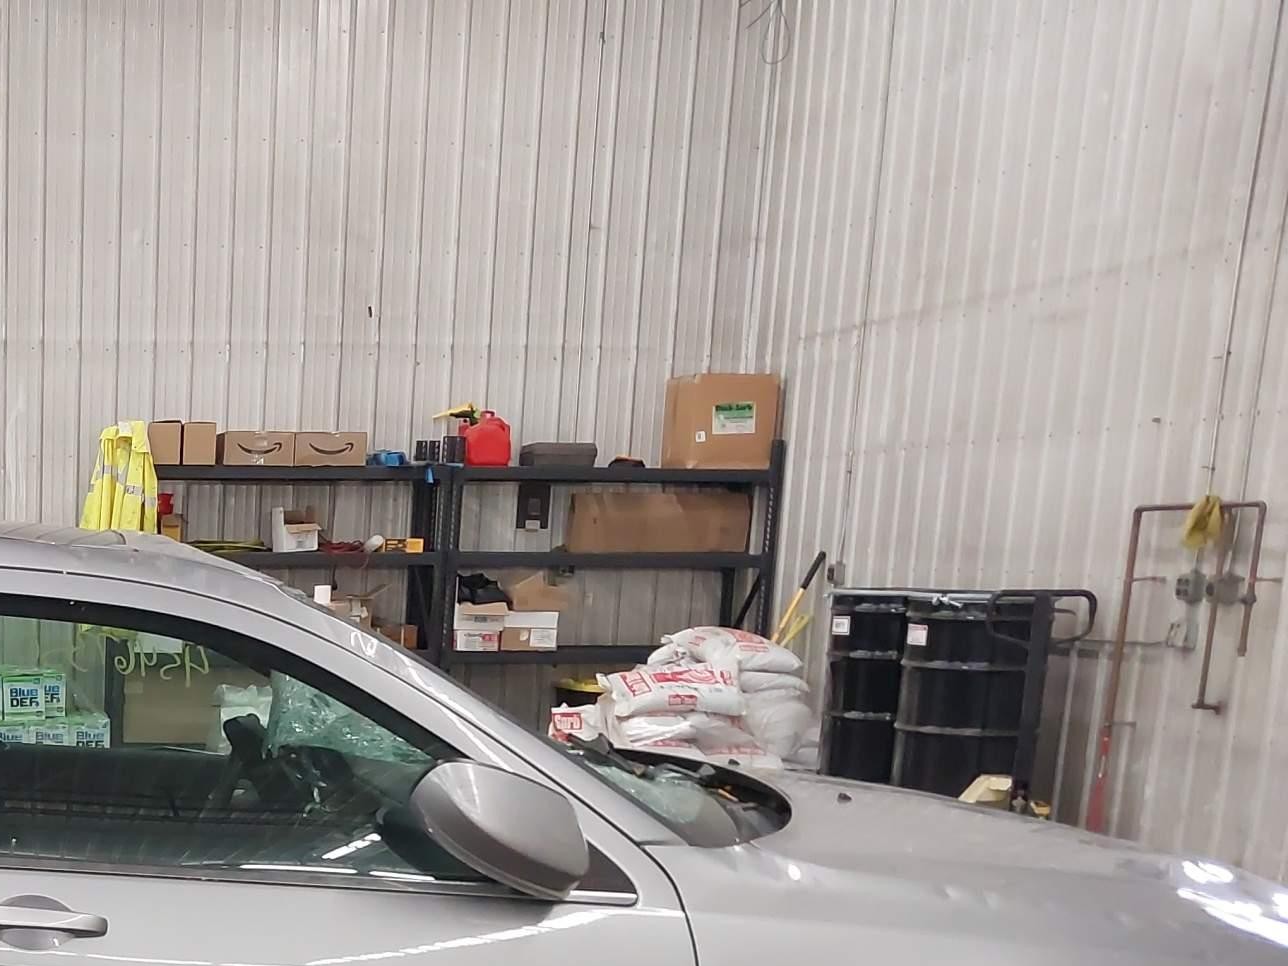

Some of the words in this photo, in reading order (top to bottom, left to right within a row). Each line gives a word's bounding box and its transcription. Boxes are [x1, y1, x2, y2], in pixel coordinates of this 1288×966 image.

[10, 687, 39, 698] Blue
[44, 684, 60, 693] ue
[10, 697, 40, 708] DEF
[35, 731, 64, 743] Blue
[76, 730, 105, 741] Blue
